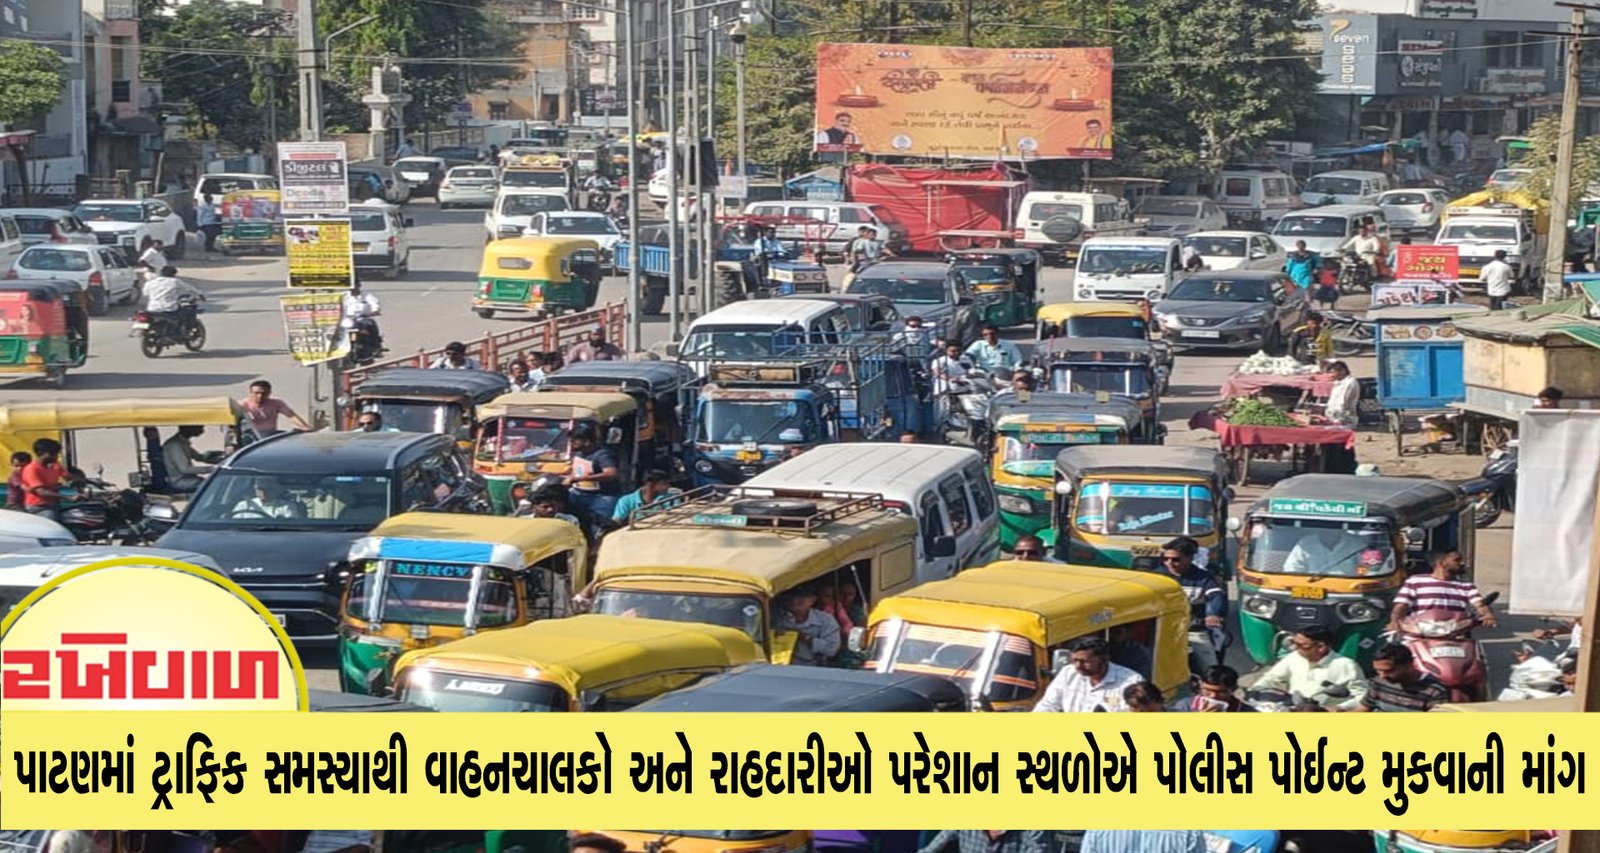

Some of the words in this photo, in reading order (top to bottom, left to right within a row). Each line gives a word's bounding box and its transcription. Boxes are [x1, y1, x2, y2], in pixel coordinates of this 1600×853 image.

[1333, 34, 1369, 44] seven
[1341, 45, 1356, 84] seas
[395, 562, 469, 578] NENCY
